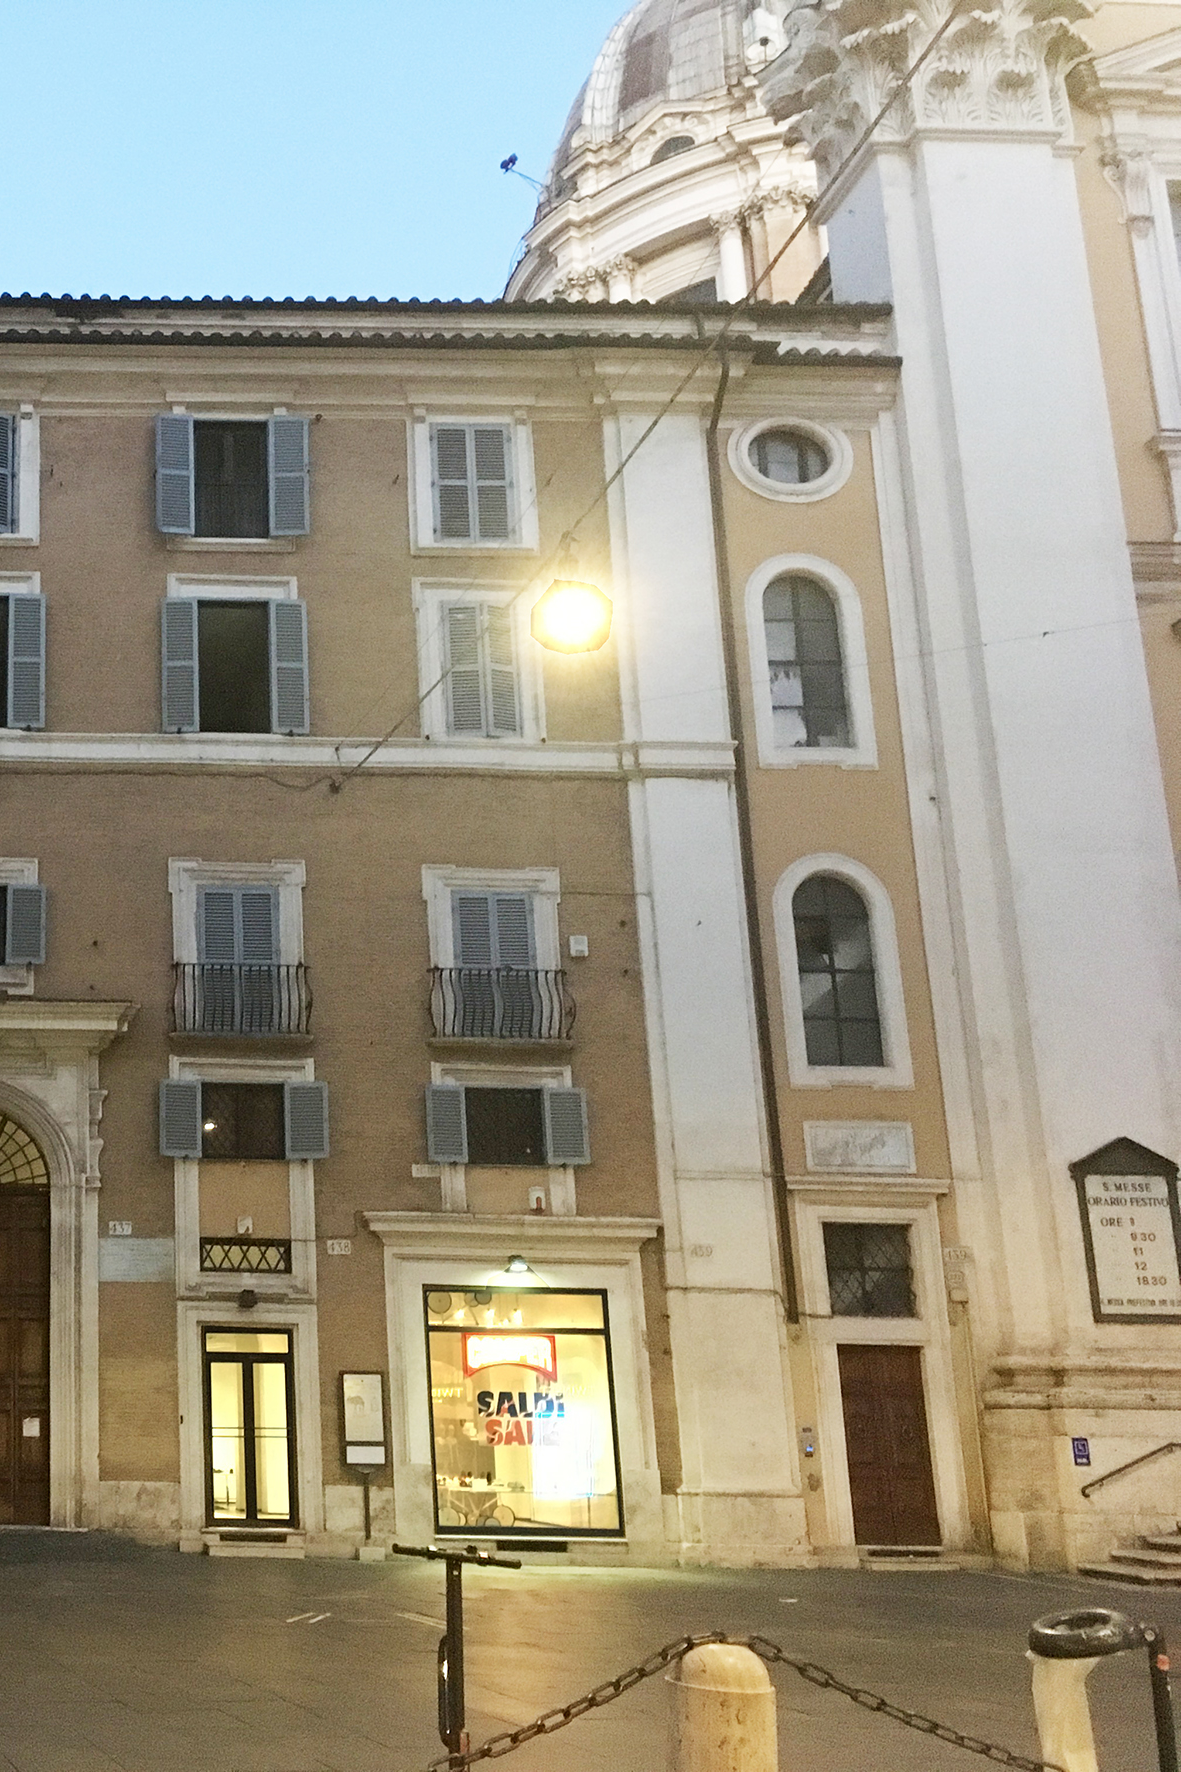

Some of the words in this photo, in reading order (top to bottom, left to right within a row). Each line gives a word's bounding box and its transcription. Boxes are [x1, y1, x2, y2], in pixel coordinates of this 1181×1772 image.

[1115, 1182, 1152, 1193] MESSE
[1088, 1197, 1127, 1207] ORARIO
[1129, 1197, 1170, 1208] FESTIVO
[1100, 1217, 1123, 1227] ORE
[1135, 1261, 1147, 1271] 12
[477, 1390, 565, 1418] SALDI
